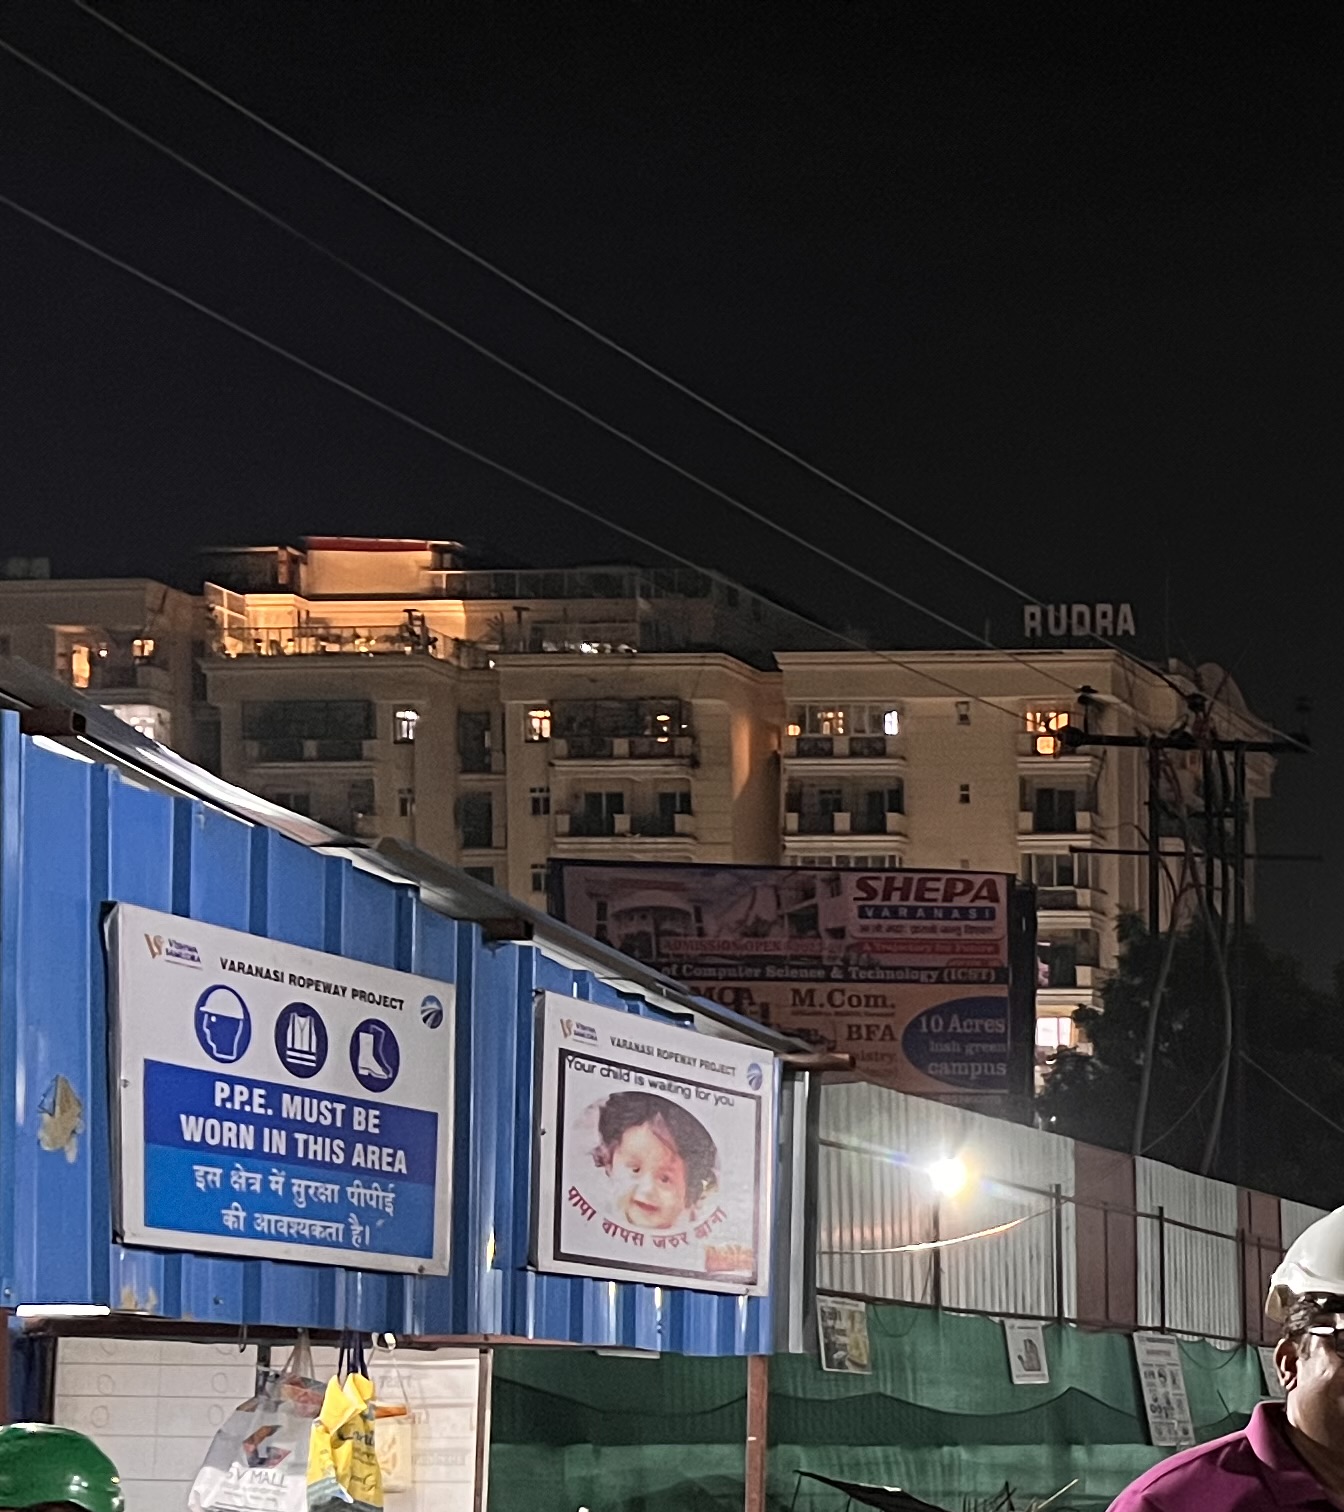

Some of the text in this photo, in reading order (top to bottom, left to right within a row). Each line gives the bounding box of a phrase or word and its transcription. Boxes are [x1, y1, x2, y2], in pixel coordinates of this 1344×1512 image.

[1023, 603, 1136, 637] RUDRA
[853, 875, 1000, 903] SHEPA
[864, 906, 991, 920] VARANASI
[745, 939, 783, 952] OPEN
[219, 957, 285, 984] VARANASI
[288, 973, 348, 998] ROPEWAY
[351, 988, 405, 1011] PROJECT
[661, 963, 677, 977] of
[682, 964, 762, 979] Computer
[766, 965, 826, 979] Science
[831, 965, 845, 979] &
[849, 966, 941, 984] Technology
[790, 988, 896, 1010] M.Com.
[846, 1023, 898, 1042] BFA
[919, 1013, 1006, 1034] 10 Acres
[610, 1036, 655, 1057] VARANASI
[656, 1048, 698, 1068] ROPEWAY
[699, 1059, 737, 1076] PROJECT
[929, 1039, 961, 1053] lush
[565, 1055, 735, 1108] Your child is waiting for you
[928, 1061, 1007, 1081] campus
[214, 1080, 381, 1134] P.P.E. MUST BE
[179, 1114, 408, 1175] WORN IN THIS AREA
[192, 1162, 396, 1217] इस क्षेत्र में सुरक्षा पीपीई
[221, 1201, 247, 1232] की
[253, 1211, 346, 1243] आवश्यकता
[566, 1185, 598, 1222] पापा
[601, 1217, 645, 1248] वापस
[250, 1469, 288, 1488] MALL
